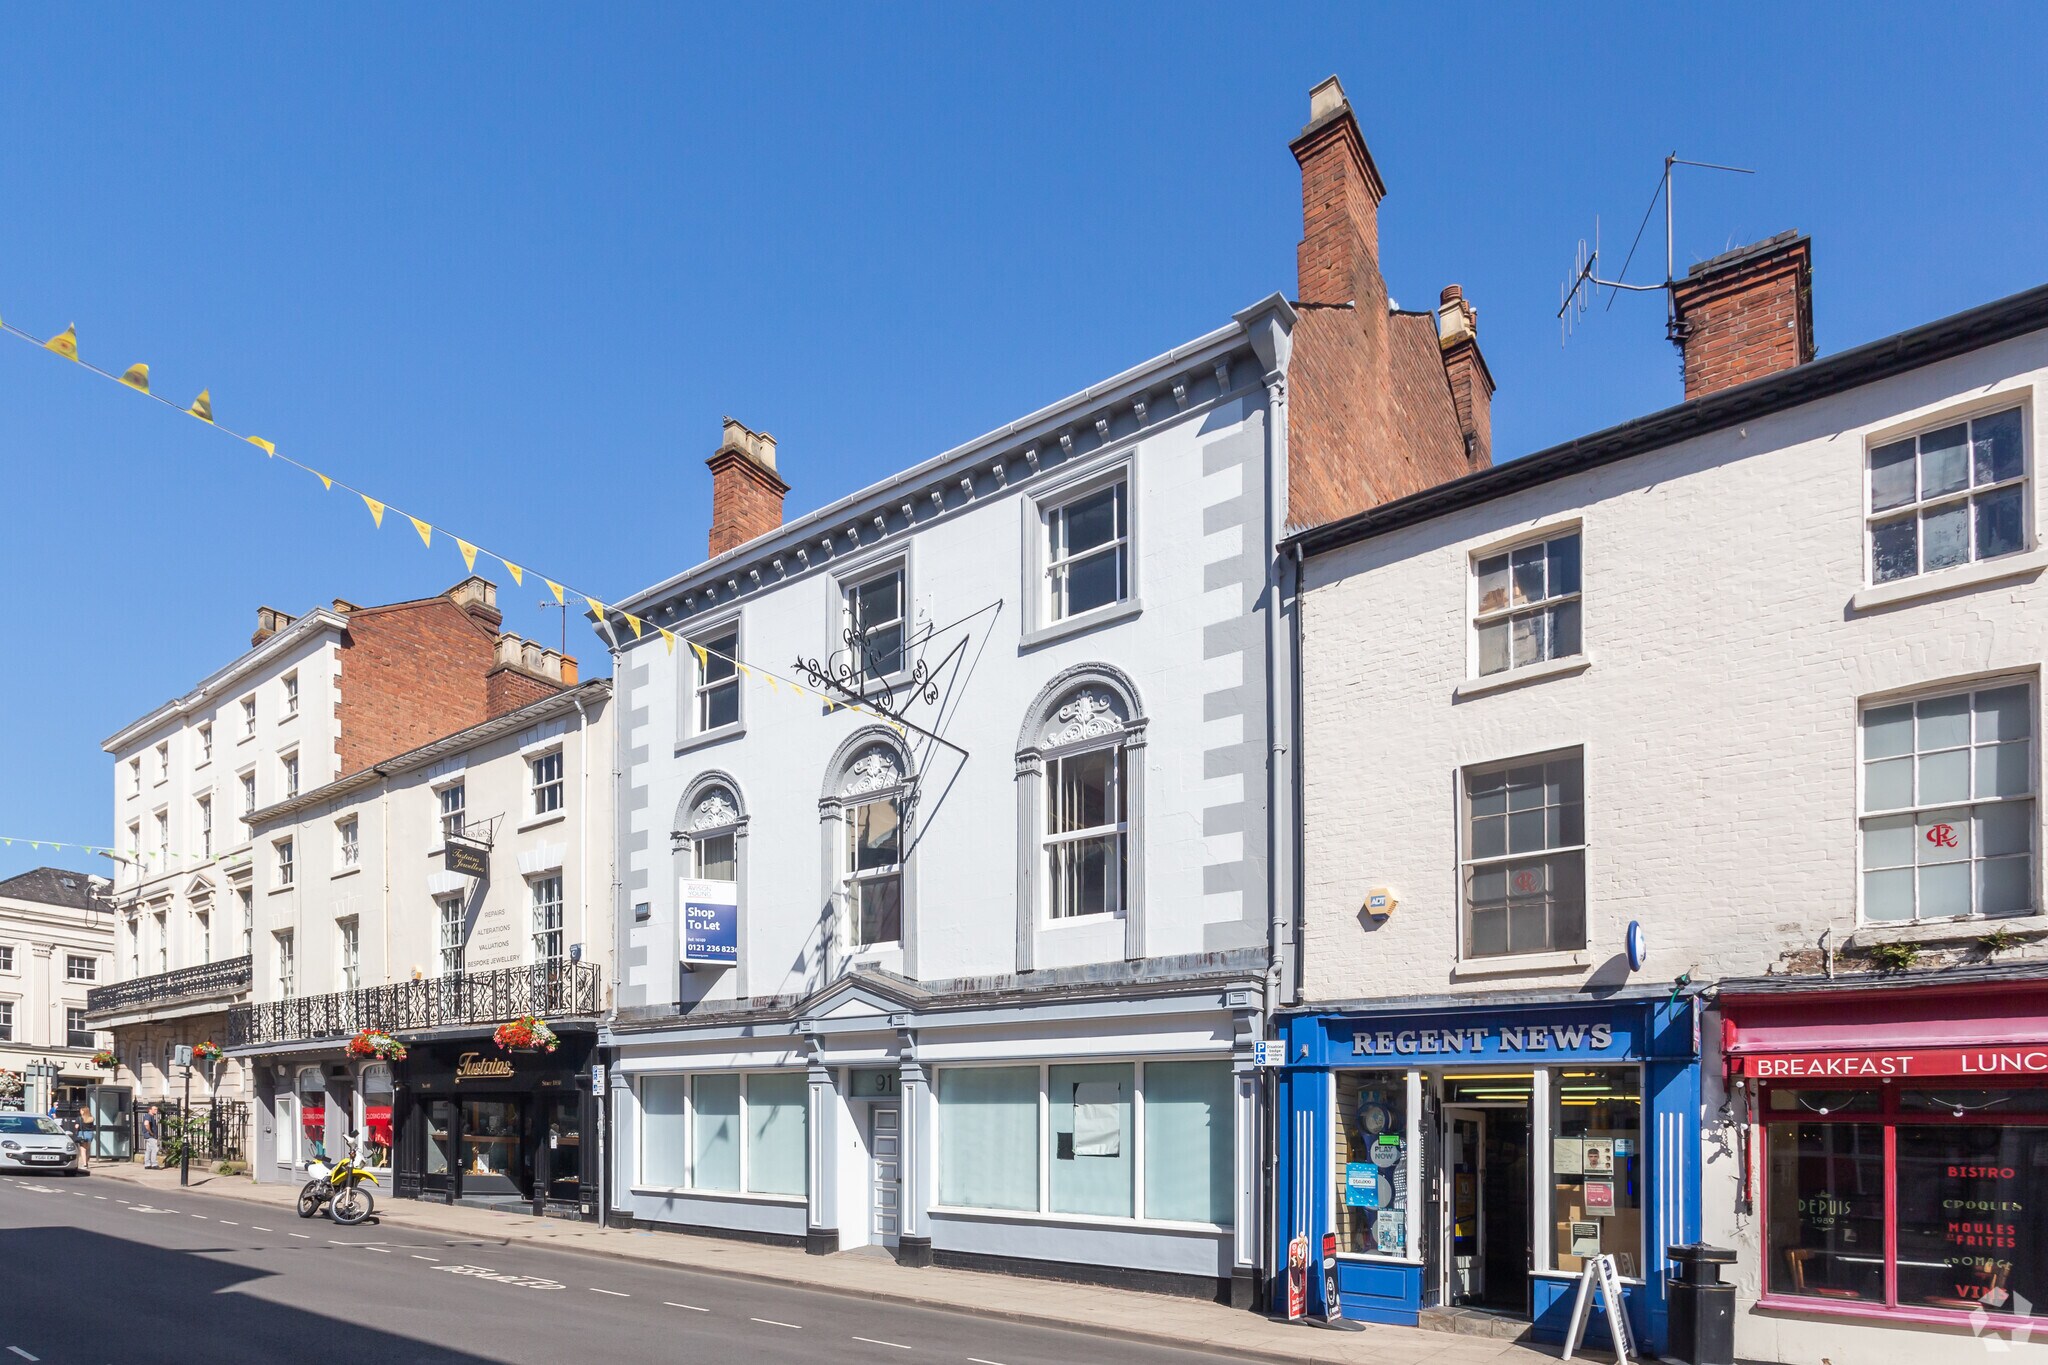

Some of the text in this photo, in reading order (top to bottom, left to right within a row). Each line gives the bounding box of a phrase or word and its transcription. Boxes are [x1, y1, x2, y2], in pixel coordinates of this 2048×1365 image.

[1371, 897, 1386, 905] ADT
[484, 908, 506, 918] REPAIRS
[688, 907, 715, 919] Shop
[477, 924, 511, 936] ALTERATIONS
[688, 919, 720, 930] To Let
[478, 940, 509, 951] VALUATIONS
[467, 954, 520, 968] BESPOKE JEWELLERY
[1352, 1023, 1613, 1055] REGENT NEWS
[31, 1059, 67, 1069] MNT
[456, 1052, 515, 1080] Tustains
[1757, 1052, 2048, 1076] BREAKFAST LUNC
[875, 1073, 892, 1092] 91
[1948, 1166, 2016, 1179] BISTRO
[1798, 1200, 1851, 1215] DEPUIS
[1812, 1217, 1835, 1225] 1989
[1948, 1222, 2016, 1235] MOULES
[1957, 1235, 2016, 1248] FRITES
